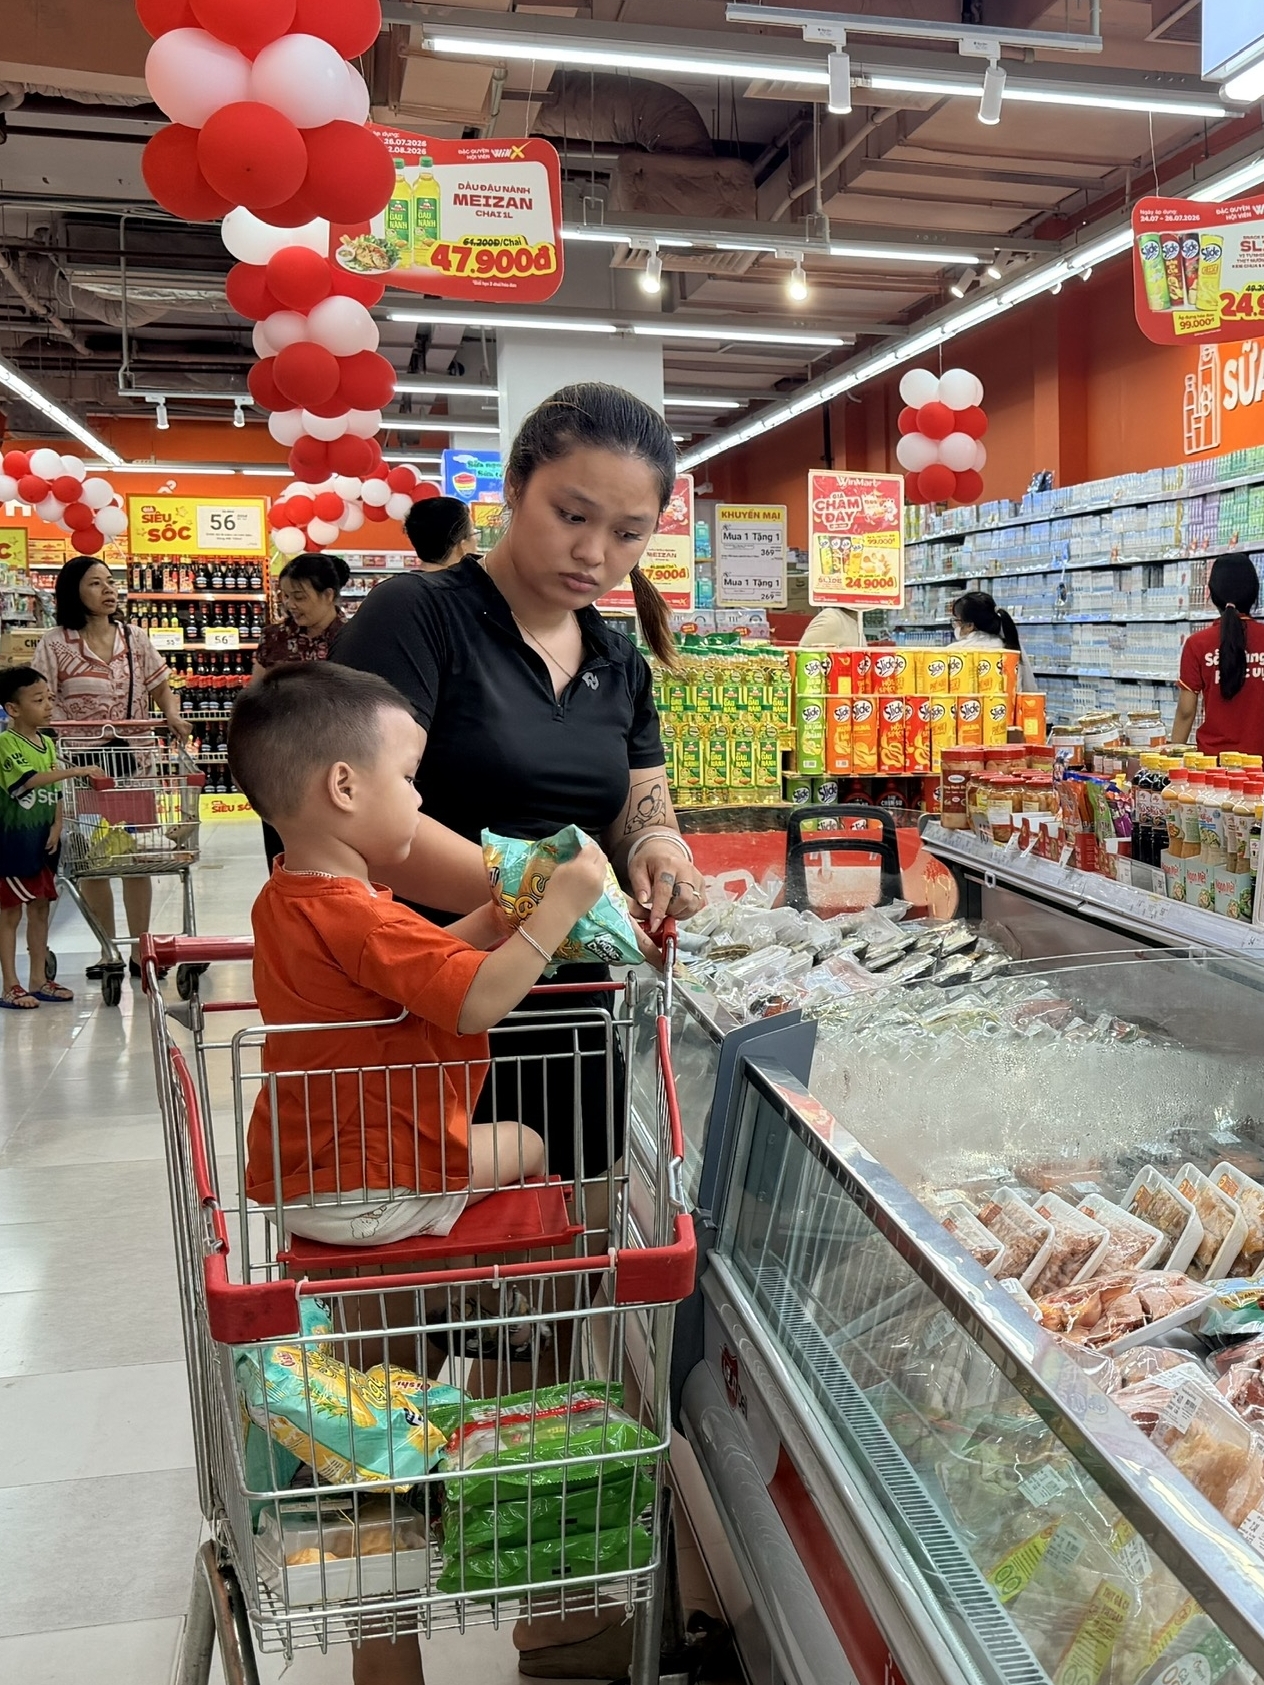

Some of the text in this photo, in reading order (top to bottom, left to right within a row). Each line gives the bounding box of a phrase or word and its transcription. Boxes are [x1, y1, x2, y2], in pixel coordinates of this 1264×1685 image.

[458, 181, 531, 195] DẦU ĐẬU NÀNH
[453, 194, 533, 211] MEIZAN
[475, 210, 502, 219] CHAI
[430, 244, 552, 274] 47.900đ
[1201, 245, 1222, 260] Slide
[836, 476, 881, 490] WinMart
[141, 511, 236, 531] SIÊU 56
[721, 508, 781, 522] KHUYẾN MẠI
[147, 519, 192, 543] SỐC
[723, 532, 780, 543] Mua 1 Tặng 1
[723, 579, 780, 588] Mua 1 Tặng 1
[845, 576, 894, 589] 24.900đ
[214, 635, 228, 644] 56
[884, 701, 904, 720] Slide
[931, 705, 945, 719] Slide
[960, 701, 981, 718] Slide
[990, 705, 1006, 719] Slide
[793, 788, 809, 804] Slide
[818, 782, 837, 802] Slide
